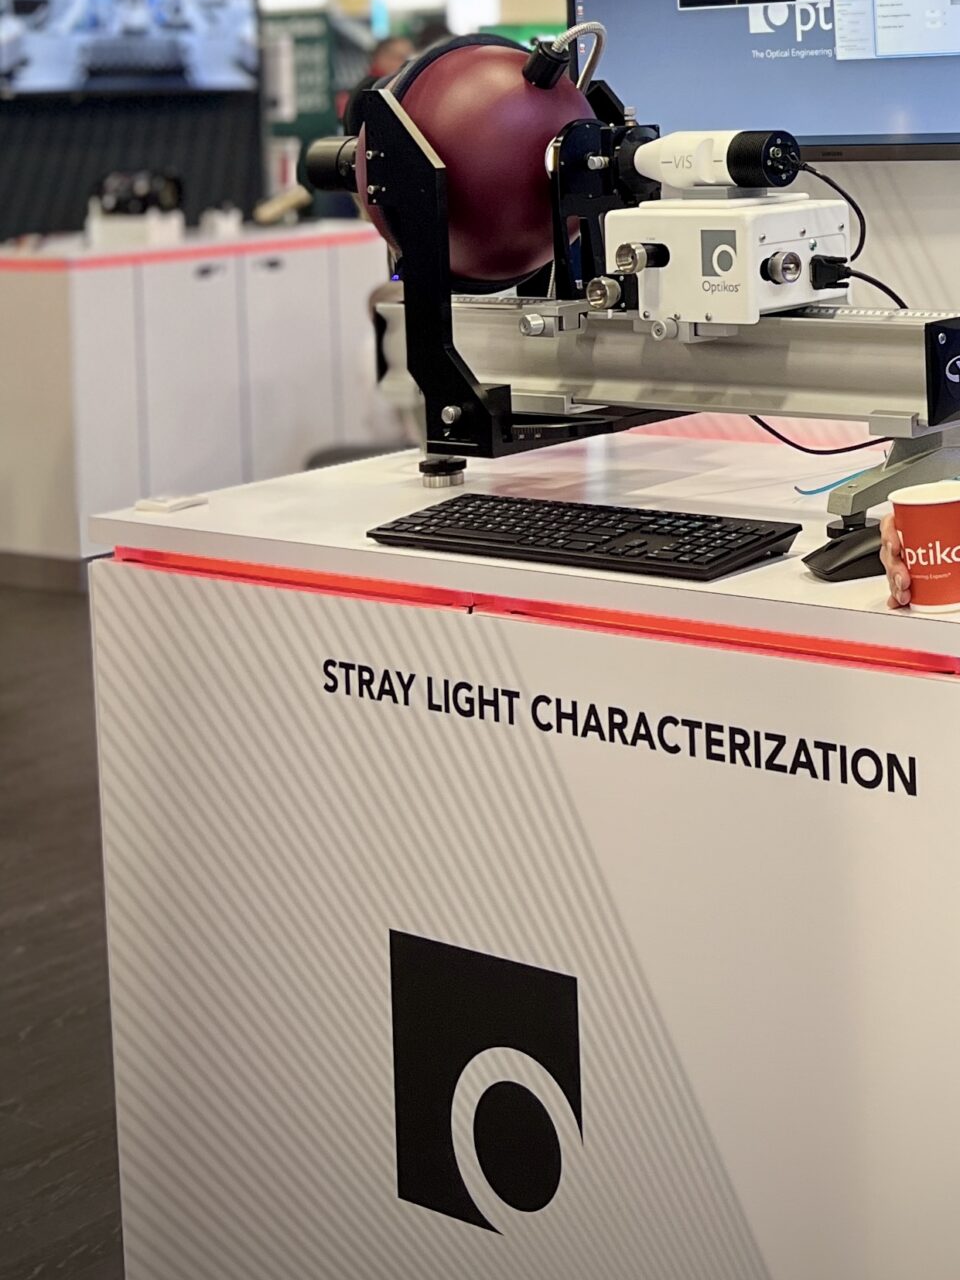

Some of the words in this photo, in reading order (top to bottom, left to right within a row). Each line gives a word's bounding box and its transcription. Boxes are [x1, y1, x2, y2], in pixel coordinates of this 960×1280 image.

[751, 49, 764, 59] The
[765, 48, 790, 60] Optical
[791, 47, 833, 59] Engineering
[673, 154, 693, 169] VIS
[701, 280, 739, 295] Optikos
[322, 658, 416, 707] STRAY
[426, 675, 521, 726] LIGHT
[530, 694, 918, 797] CHARACTERIZATION
